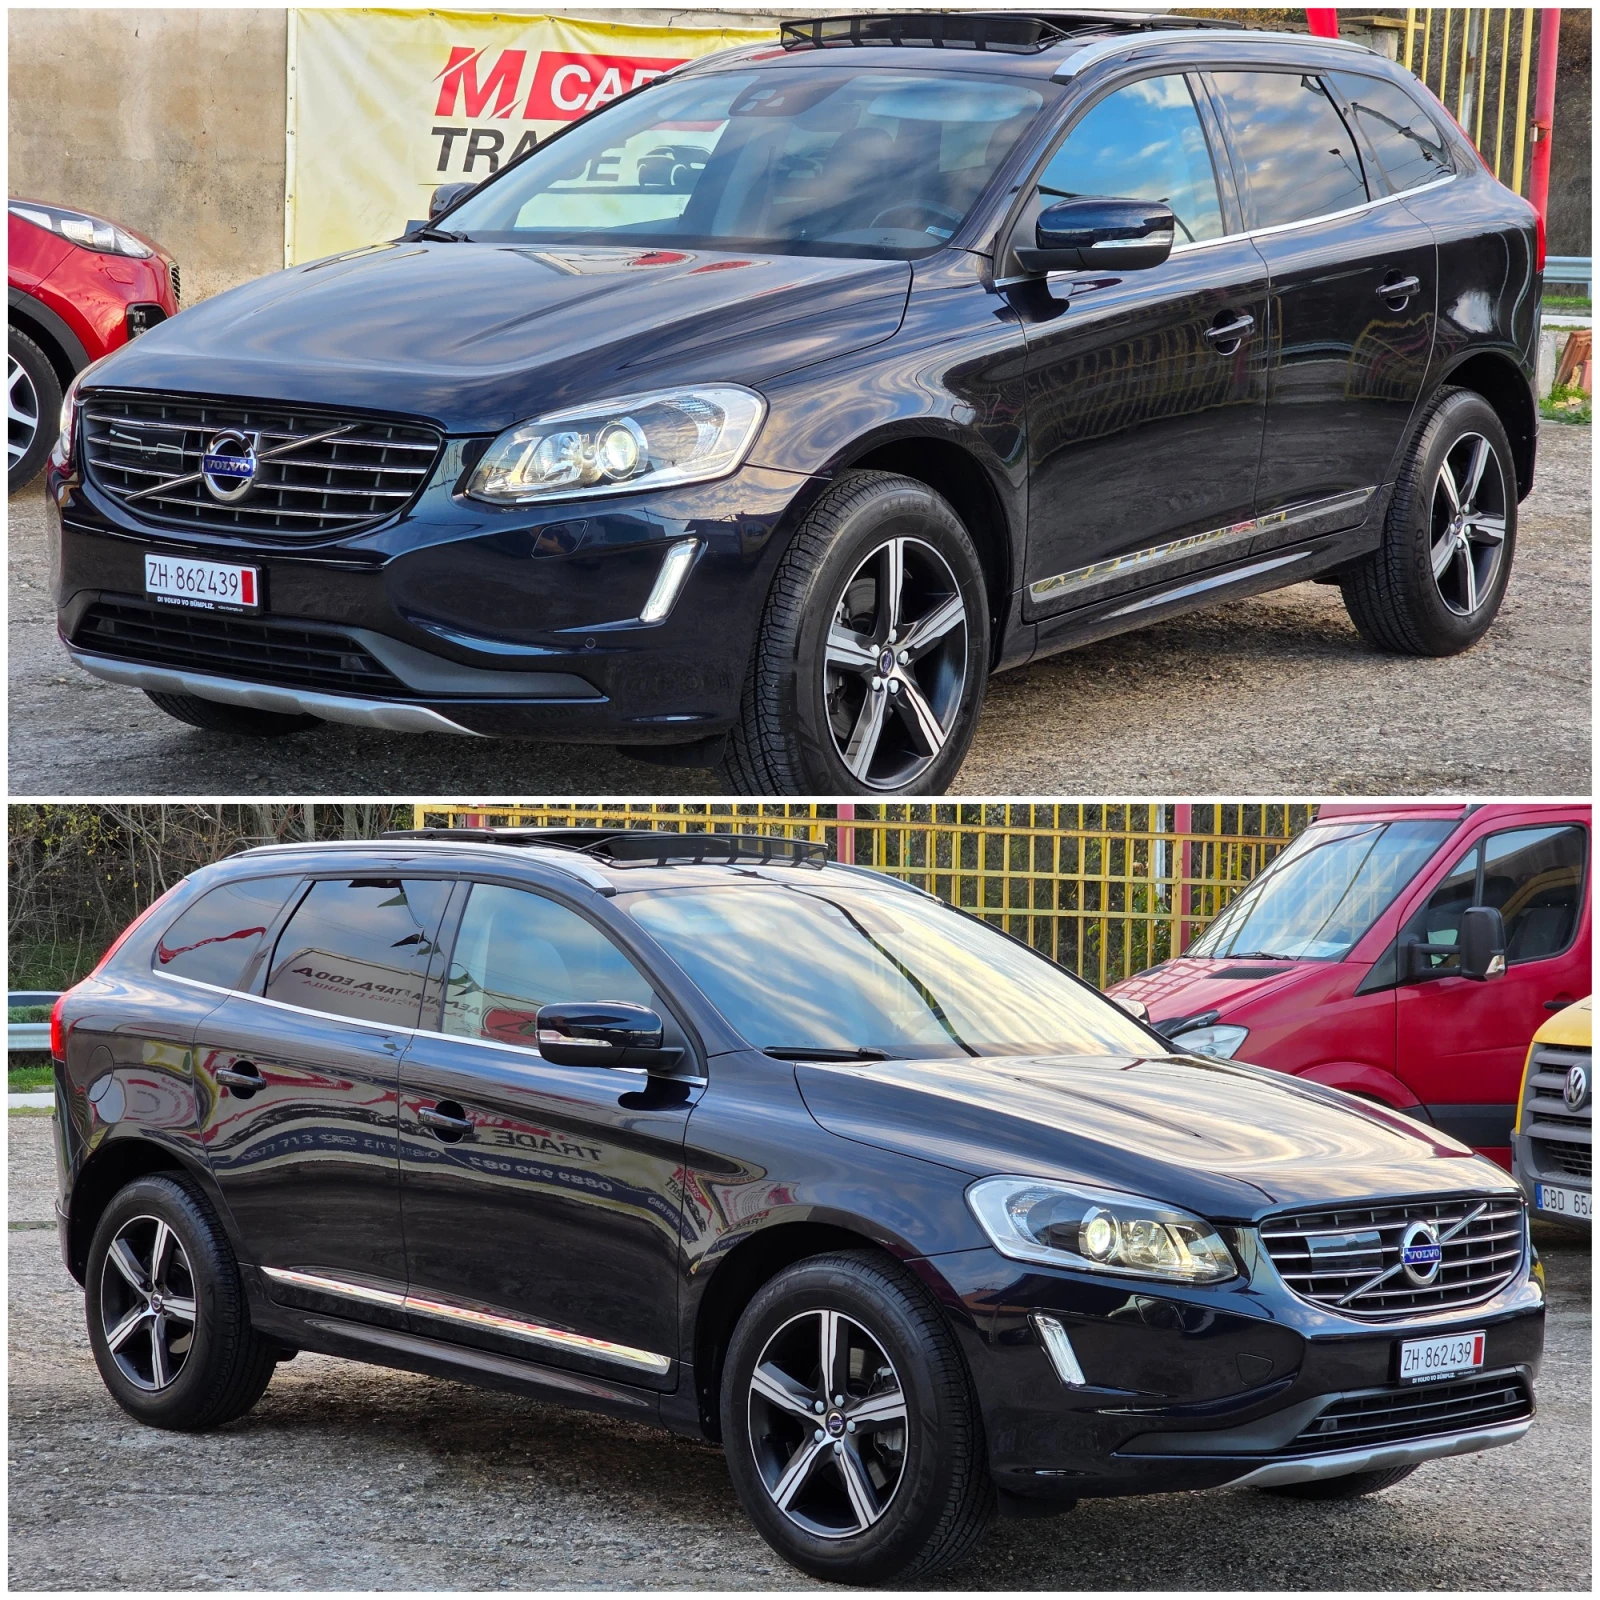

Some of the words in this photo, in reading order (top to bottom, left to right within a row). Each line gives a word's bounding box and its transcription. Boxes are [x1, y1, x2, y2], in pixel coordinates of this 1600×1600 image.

[432, 44, 527, 120] M
[206, 459, 251, 473] VOLVO
[1543, 1188, 1565, 1211] CBD
[1407, 1248, 1440, 1260] VOLVO
